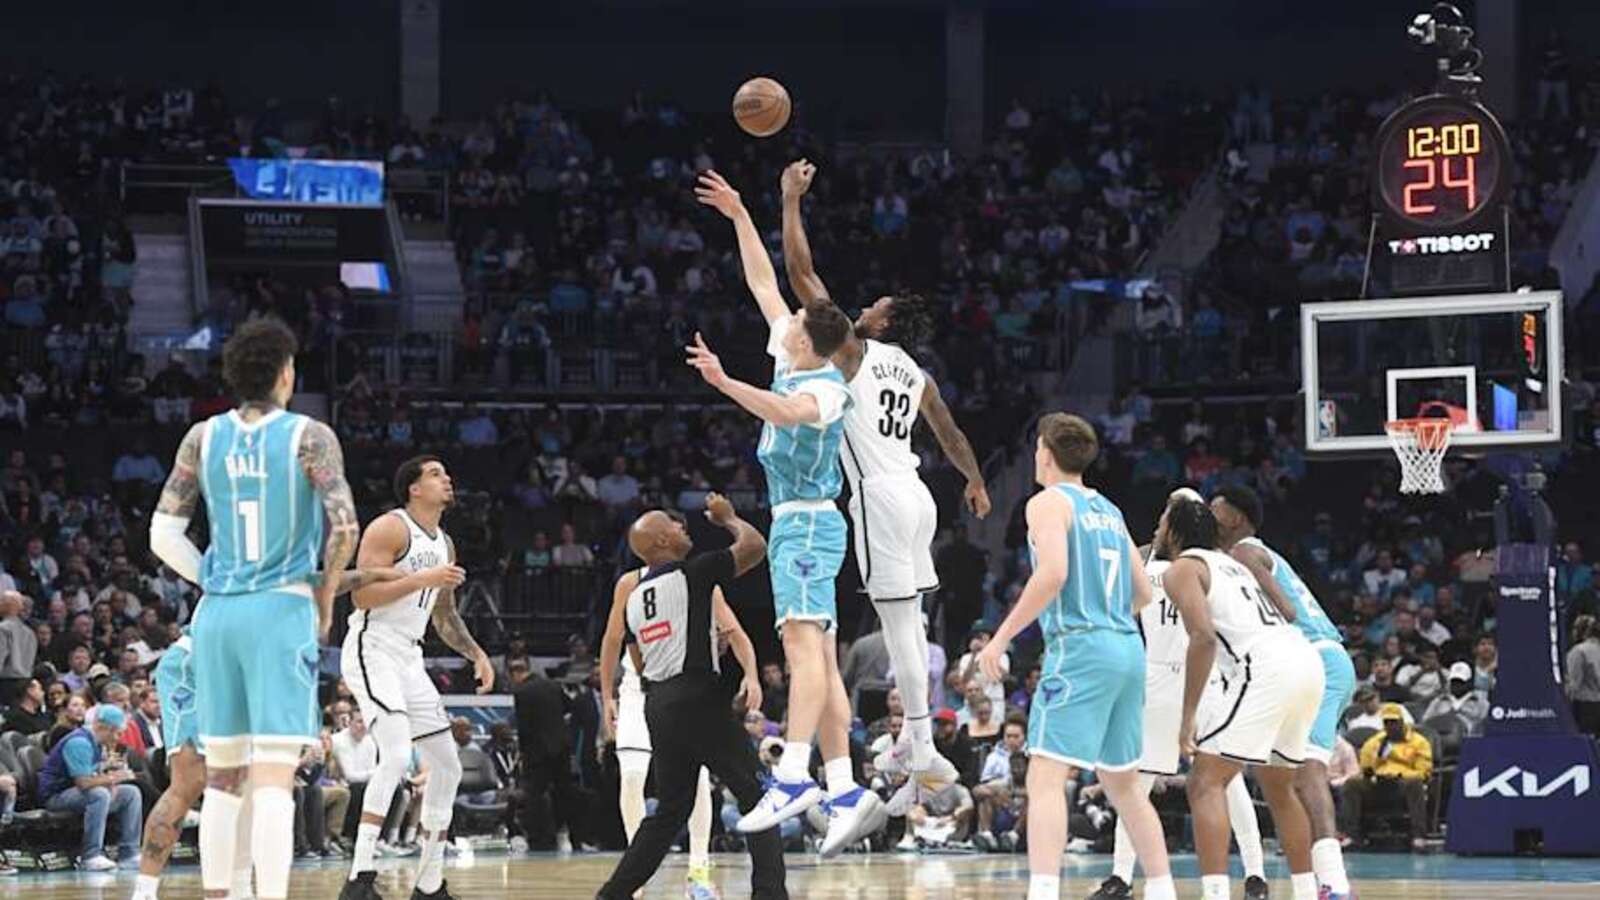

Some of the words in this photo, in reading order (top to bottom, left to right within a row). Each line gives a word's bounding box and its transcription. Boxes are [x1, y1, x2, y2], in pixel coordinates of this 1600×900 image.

[1408, 124, 1480, 157] 12:00
[1403, 157, 1475, 214] 24
[1417, 233, 1494, 253] TISSOT
[879, 389, 910, 439] 33
[225, 454, 268, 478] BALL
[238, 500, 259, 560] 1
[1099, 547, 1120, 601] 7
[643, 586, 656, 620] 8
[1158, 597, 1178, 625] 14
[1464, 764, 1590, 798] KIA
